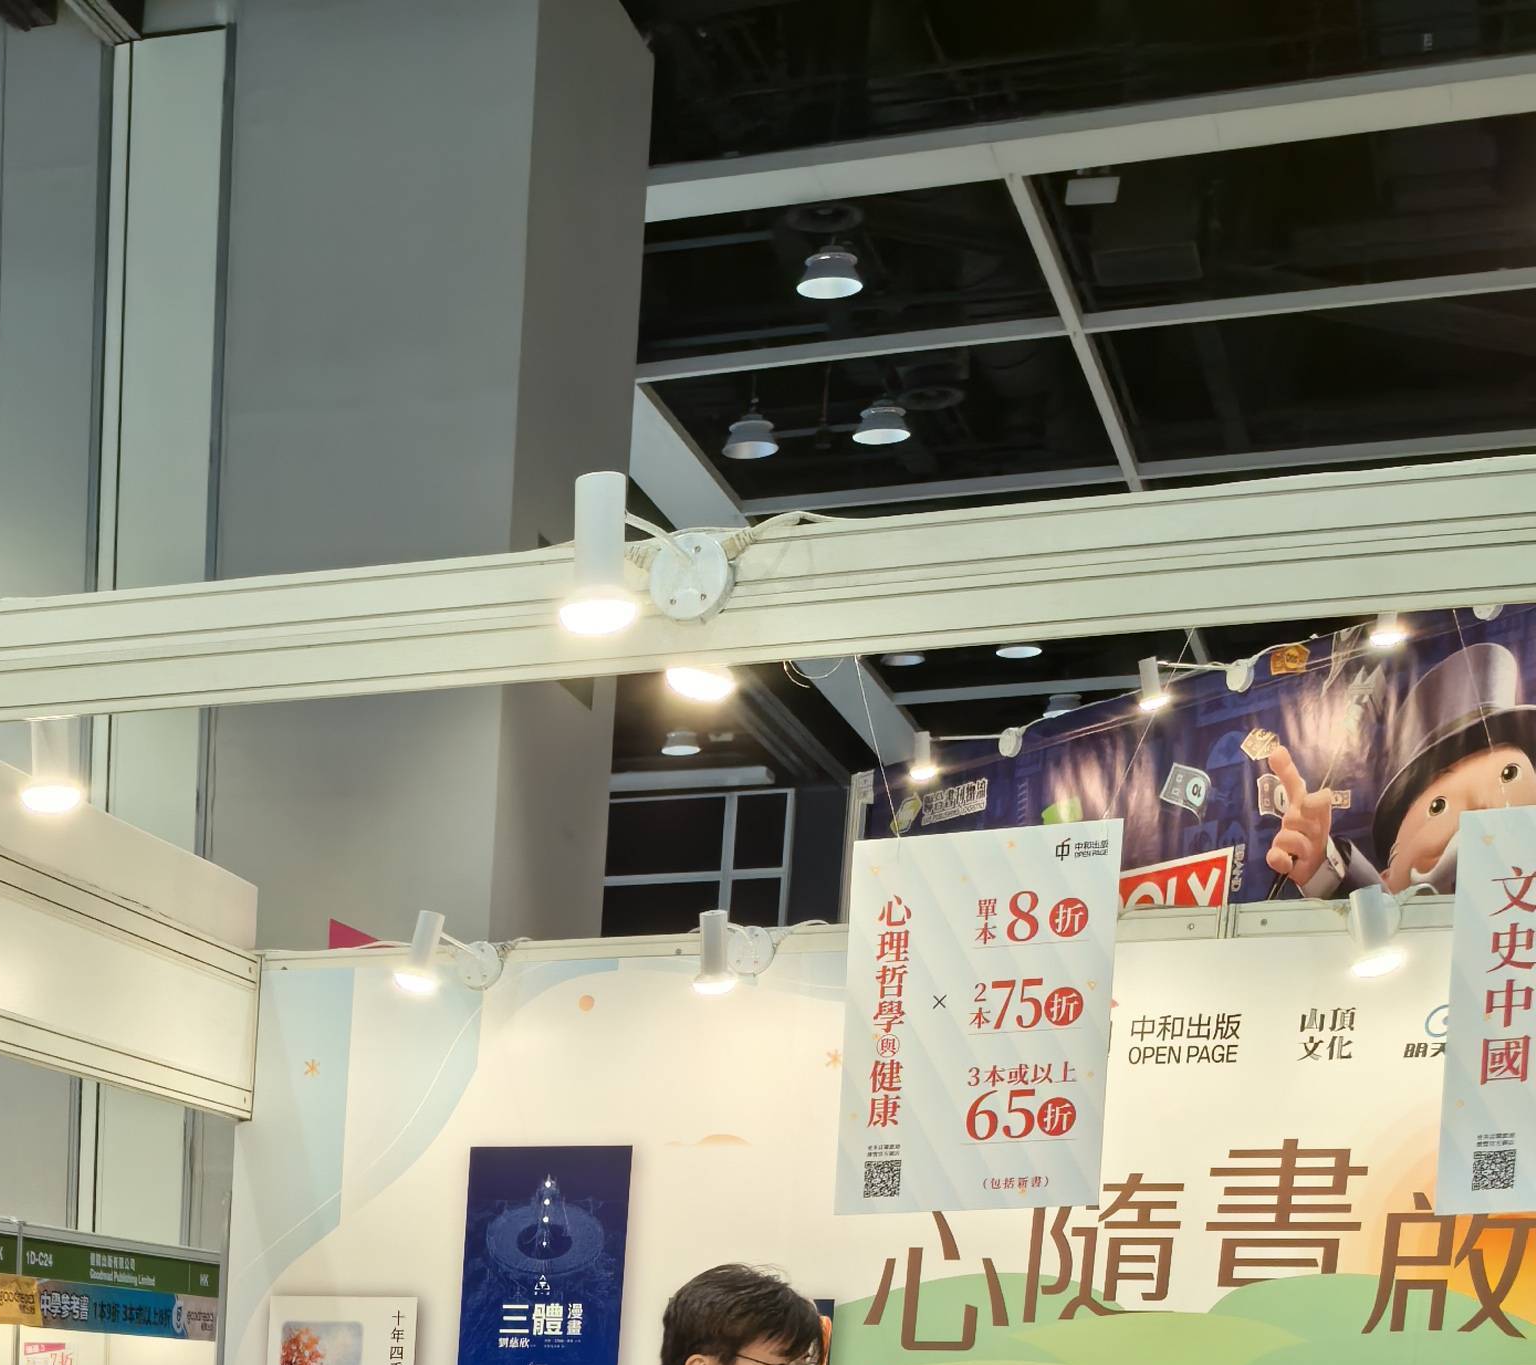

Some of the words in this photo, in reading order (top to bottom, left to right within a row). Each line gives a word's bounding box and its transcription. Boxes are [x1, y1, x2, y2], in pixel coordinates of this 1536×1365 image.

[974, 898, 998, 945] 單本
[1130, 1012, 1242, 1042] 中和出版
[1128, 1045, 1181, 1065] OPEN
[1186, 1044, 1238, 1064] PAGE
[967, 1062, 1077, 1088] 3本或以上
[499, 1303, 563, 1336] 三體
